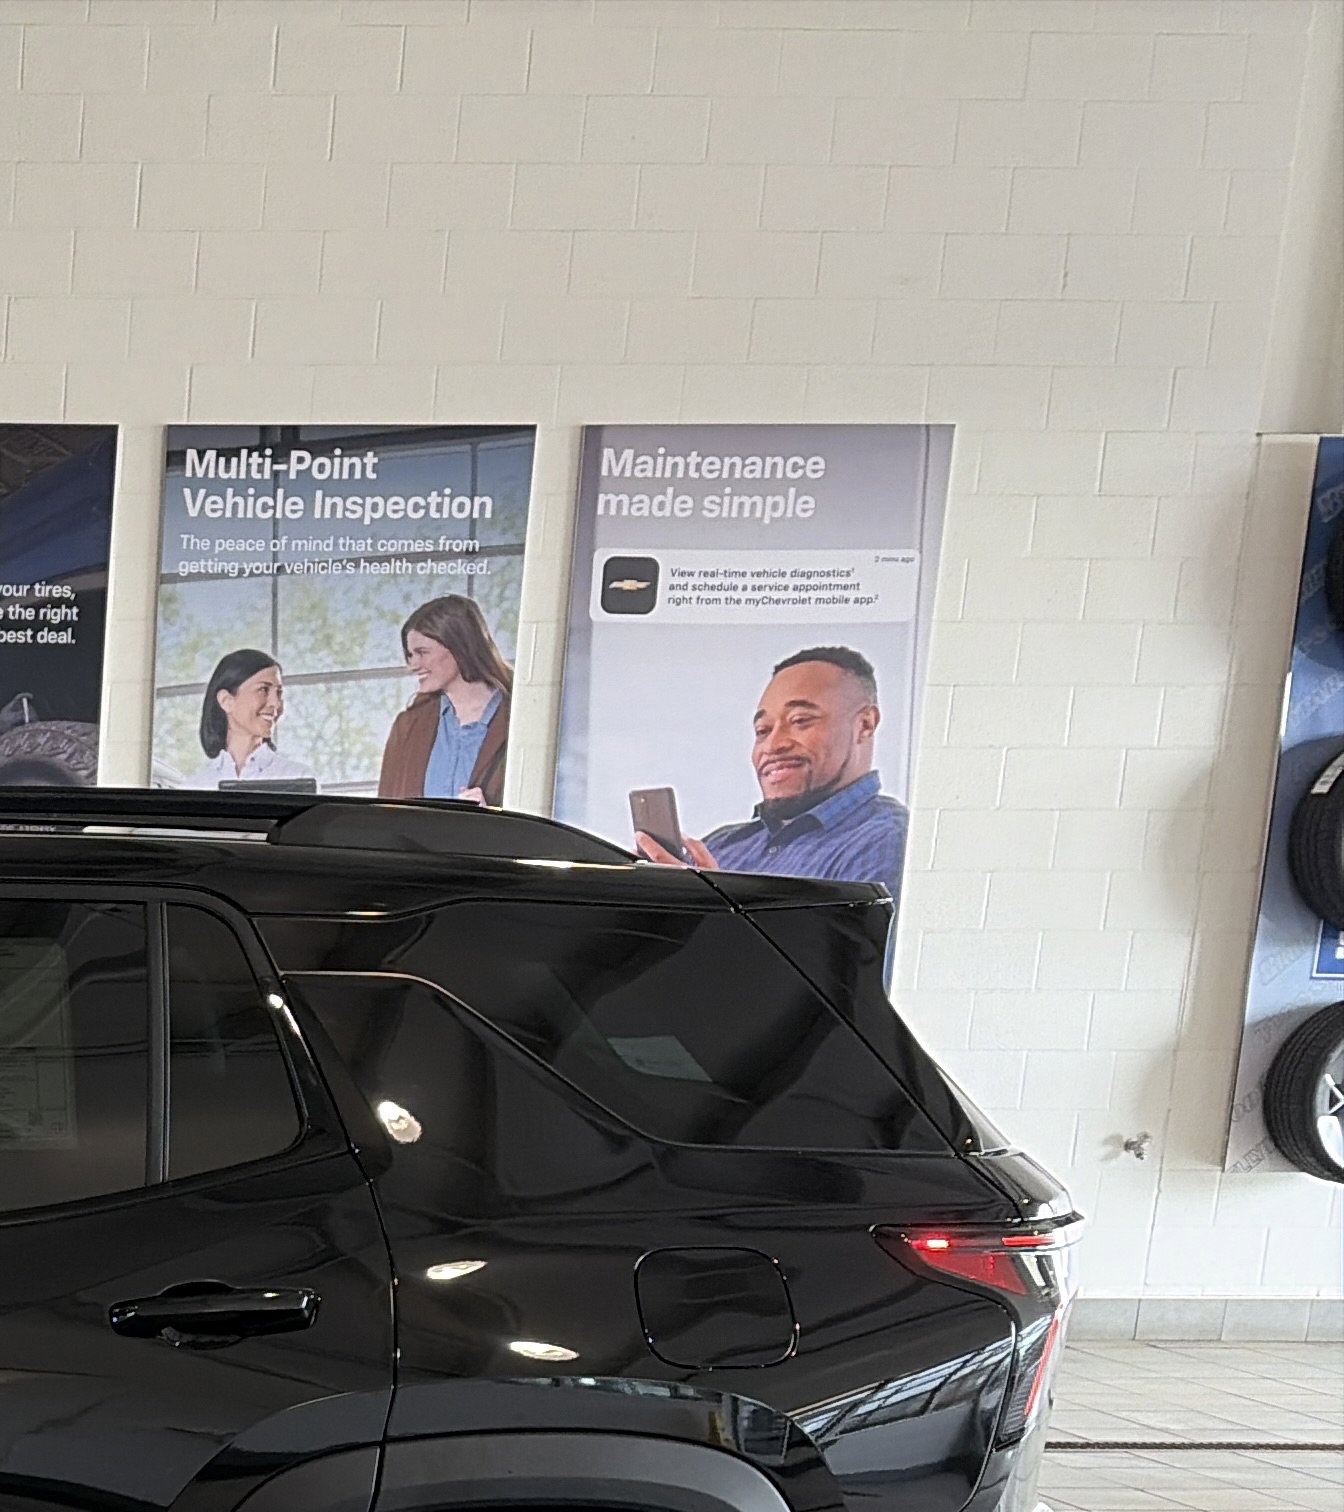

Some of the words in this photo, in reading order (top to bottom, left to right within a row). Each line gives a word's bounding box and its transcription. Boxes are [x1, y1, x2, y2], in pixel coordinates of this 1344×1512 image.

[184, 448, 378, 481] Multi-Point
[601, 447, 826, 479] Maintenance
[183, 487, 305, 520] Vehicle
[314, 488, 493, 525] Inspection
[597, 487, 693, 518] made
[702, 487, 815, 524] simple
[180, 534, 211, 551] The
[215, 538, 265, 553] peace
[270, 535, 288, 552] of
[292, 536, 334, 552] mind
[338, 536, 373, 553] that
[377, 539, 434, 553] comes
[438, 536, 480, 553] from
[178, 558, 239, 577] getting
[242, 561, 281, 577] your
[285, 558, 356, 576] vehicle's
[360, 559, 412, 576] health
[417, 559, 491, 576] checked.
[670, 567, 696, 579] View
[698, 567, 747, 579] real-time
[750, 567, 787, 579] vehicle
[33, 582, 76, 600] tires,
[669, 581, 688, 592] and
[691, 581, 739, 592] schedule
[741, 584, 748, 592] a
[751, 582, 789, 592] service
[792, 581, 860, 594] appointment
[667, 594, 693, 606] right
[696, 594, 721, 605] from
[724, 594, 742, 605] the
[745, 594, 812, 607] myChevrolet
[815, 594, 850, 605] mobile
[7, 605, 35, 621] the
[39, 605, 79, 625] right
[36, 628, 76, 645] deal.
